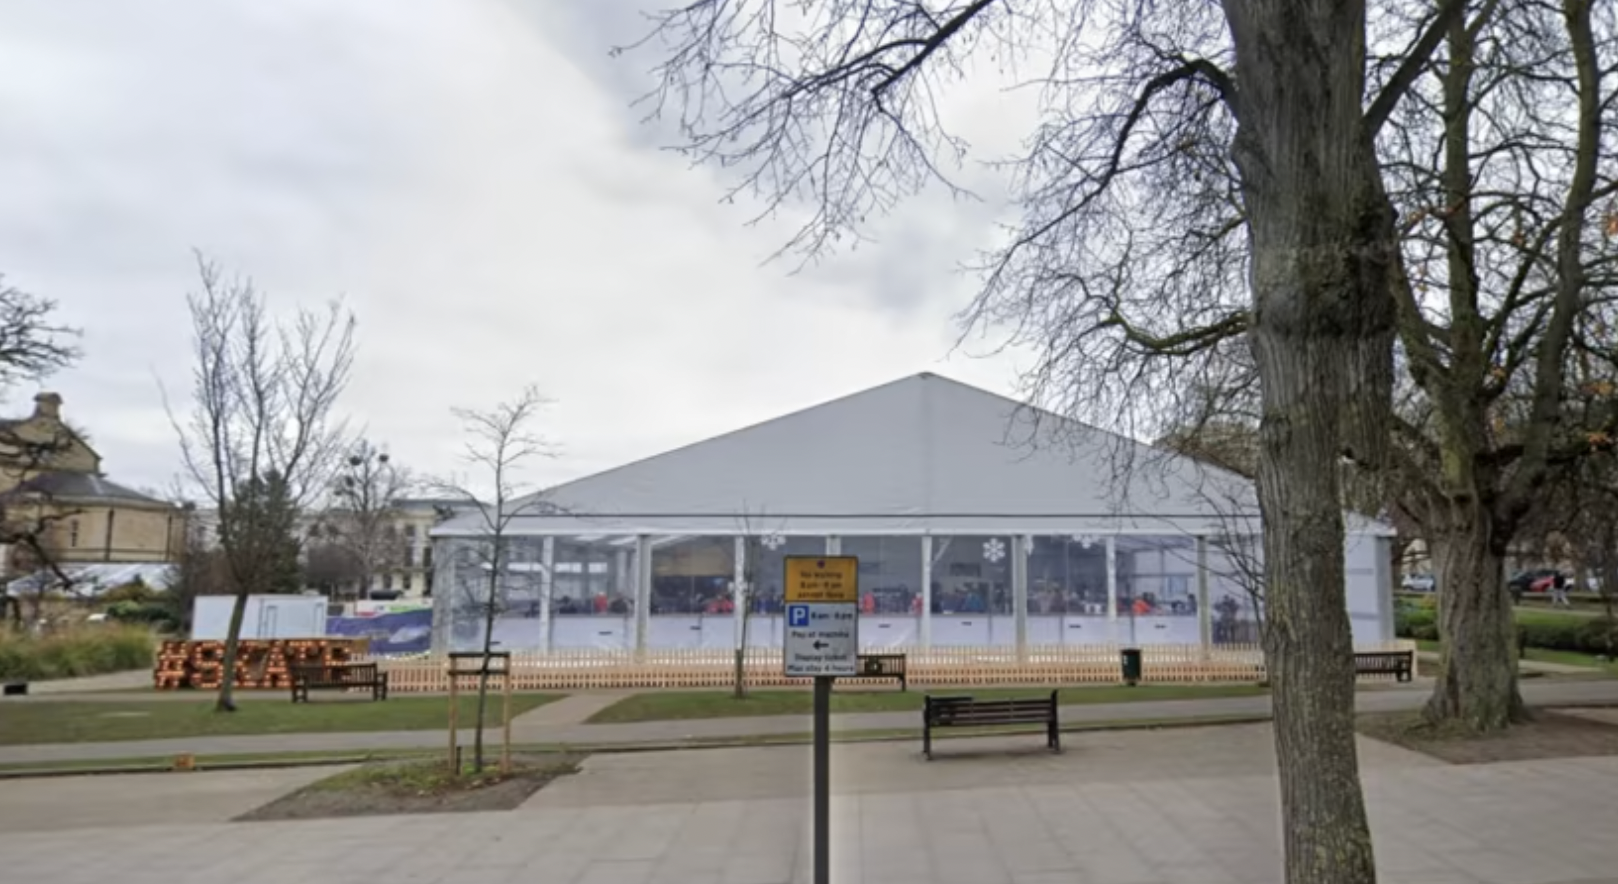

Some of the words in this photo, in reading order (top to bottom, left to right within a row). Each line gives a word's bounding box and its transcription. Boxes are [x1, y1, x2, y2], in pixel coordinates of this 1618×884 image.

[793, 607, 806, 625] P
[791, 630, 806, 640] Pay
[787, 664, 804, 672] Max
[805, 664, 821, 673] stay
